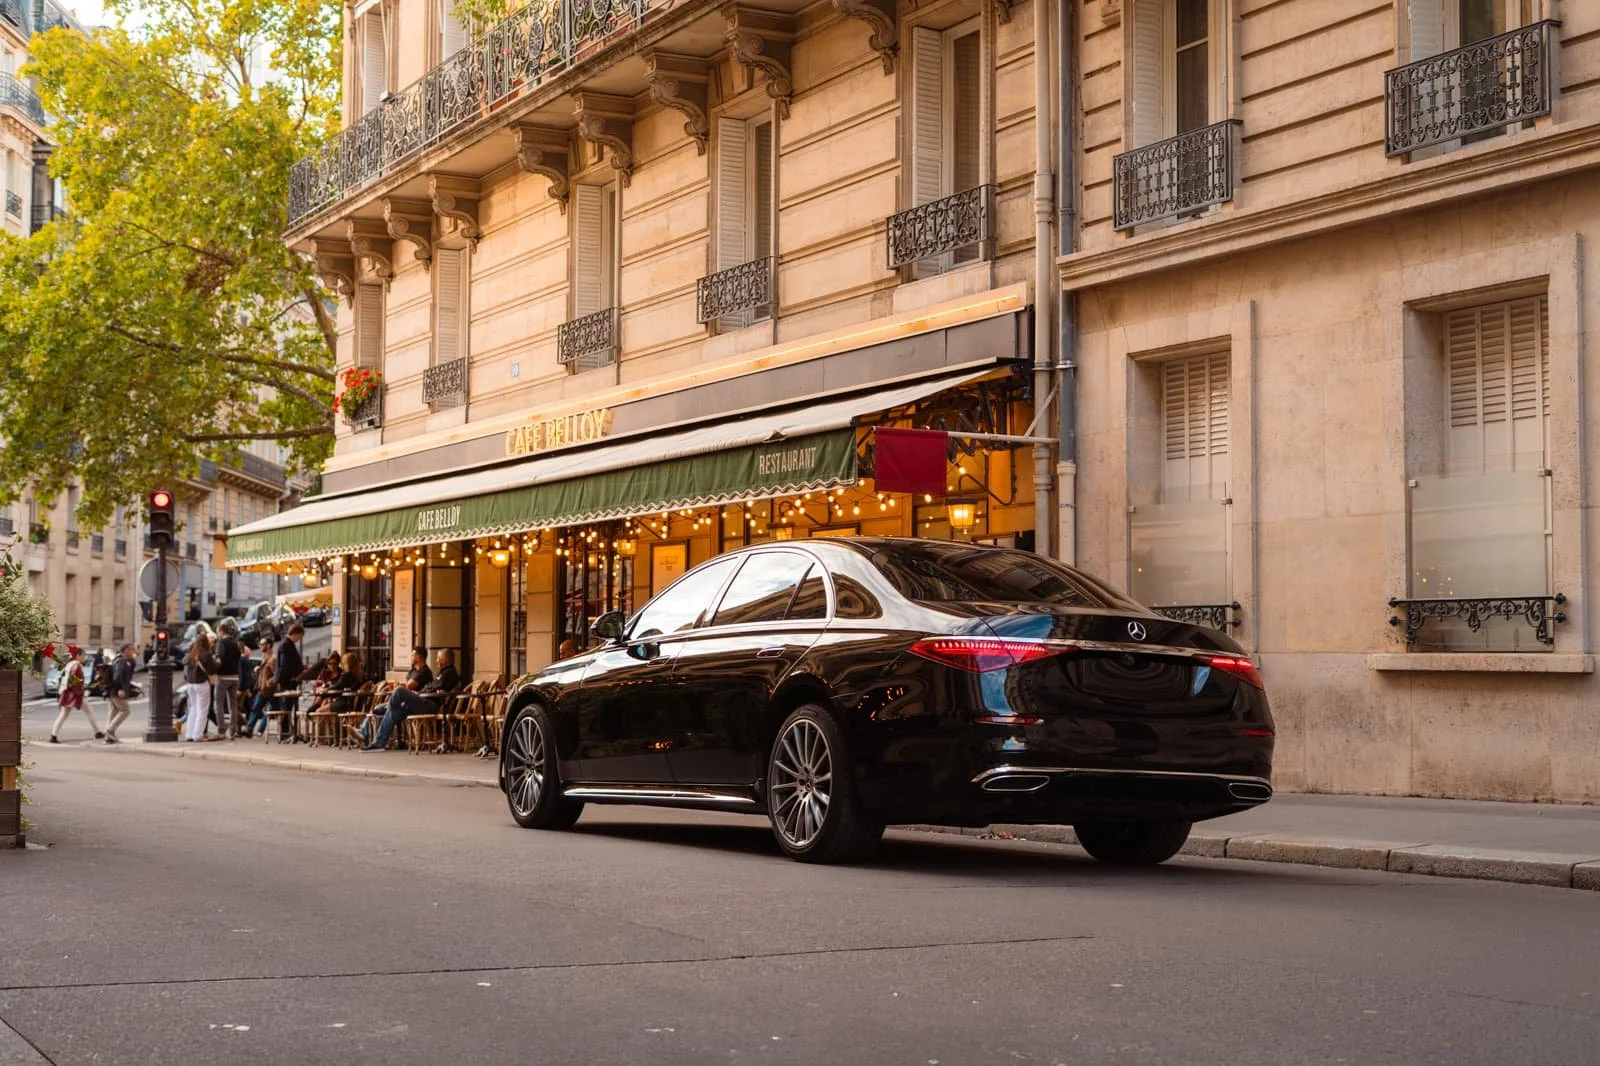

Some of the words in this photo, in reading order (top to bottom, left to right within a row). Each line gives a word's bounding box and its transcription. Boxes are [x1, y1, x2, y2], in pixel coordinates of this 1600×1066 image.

[545, 408, 606, 449] BELLOY
[759, 447, 817, 475] RESTAURANT
[435, 505, 461, 529] BELLOY
